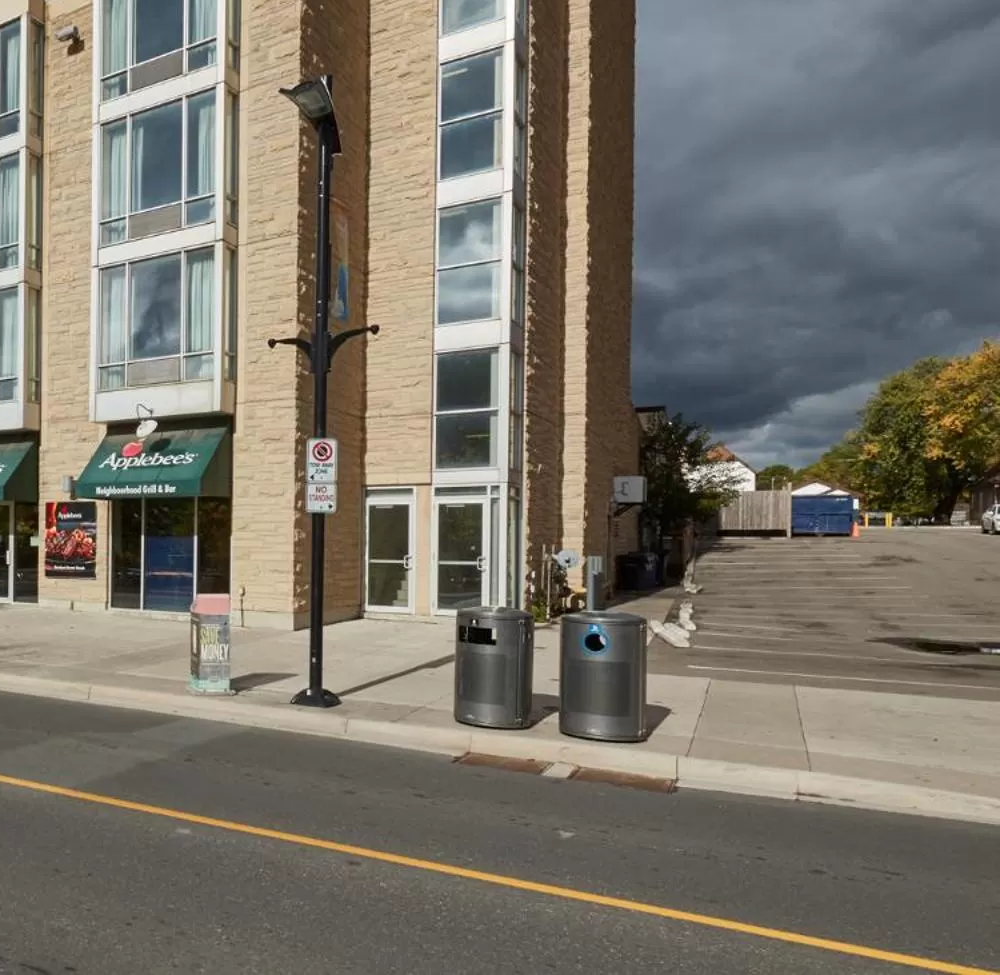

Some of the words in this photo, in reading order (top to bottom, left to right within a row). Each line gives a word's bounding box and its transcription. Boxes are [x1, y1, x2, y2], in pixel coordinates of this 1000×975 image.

[98, 451, 194, 471] Applebee's
[95, 485, 141, 497] Neighbourhood
[315, 486, 328, 494] NO
[201, 643, 230, 662] MONEY
